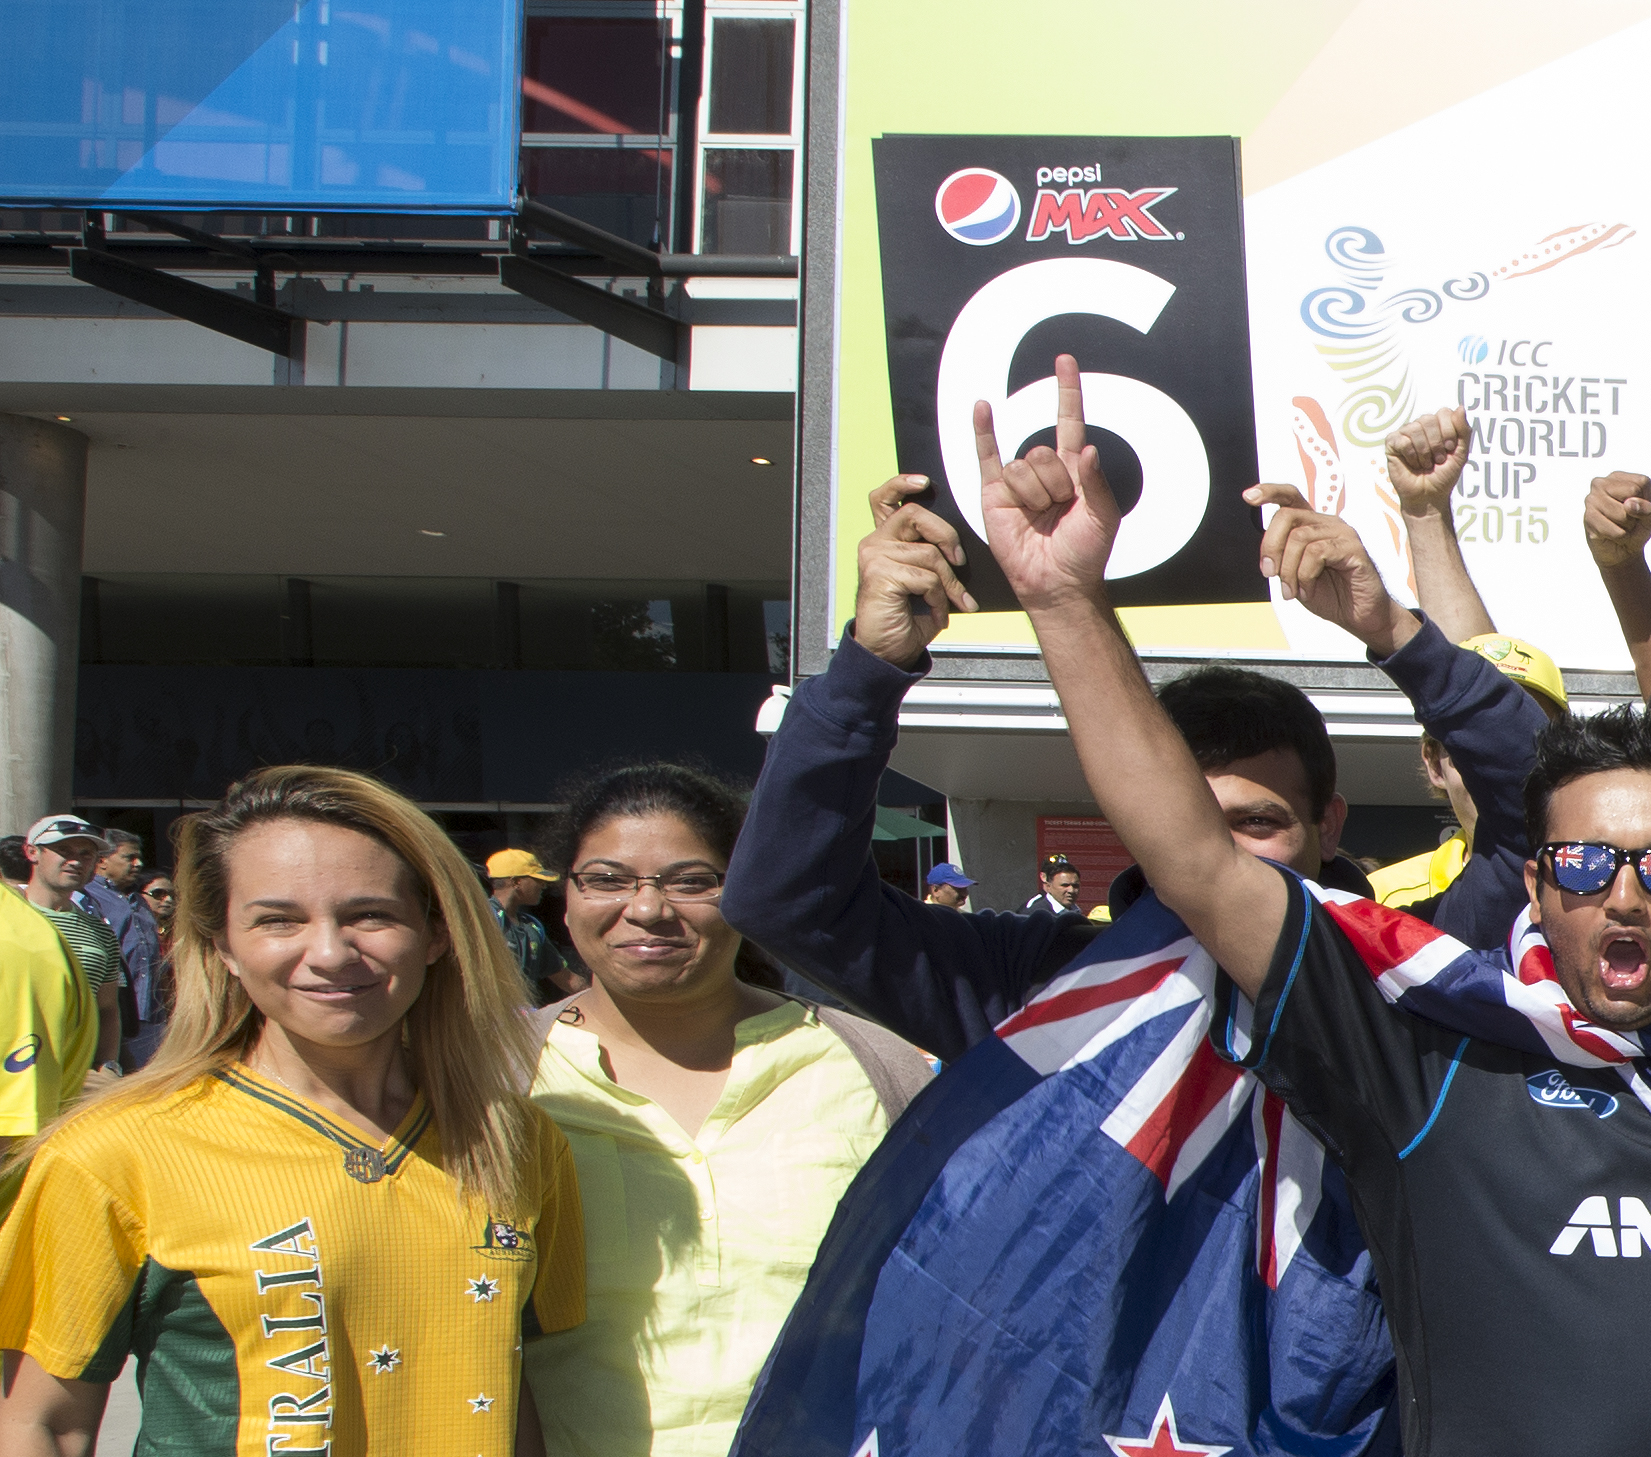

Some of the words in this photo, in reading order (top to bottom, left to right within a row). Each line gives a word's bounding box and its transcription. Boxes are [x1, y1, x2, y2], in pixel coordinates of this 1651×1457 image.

[1036, 162, 1102, 187] pepsi
[1026, 187, 1179, 245] MAX
[1497, 339, 1553, 367] ICC
[1457, 372, 1627, 415] CRICKET
[936, 256, 1210, 581] 6
[1469, 416, 1607, 458] WORLD
[1457, 460, 1536, 499] CUP
[1456, 504, 1549, 544] 2015
